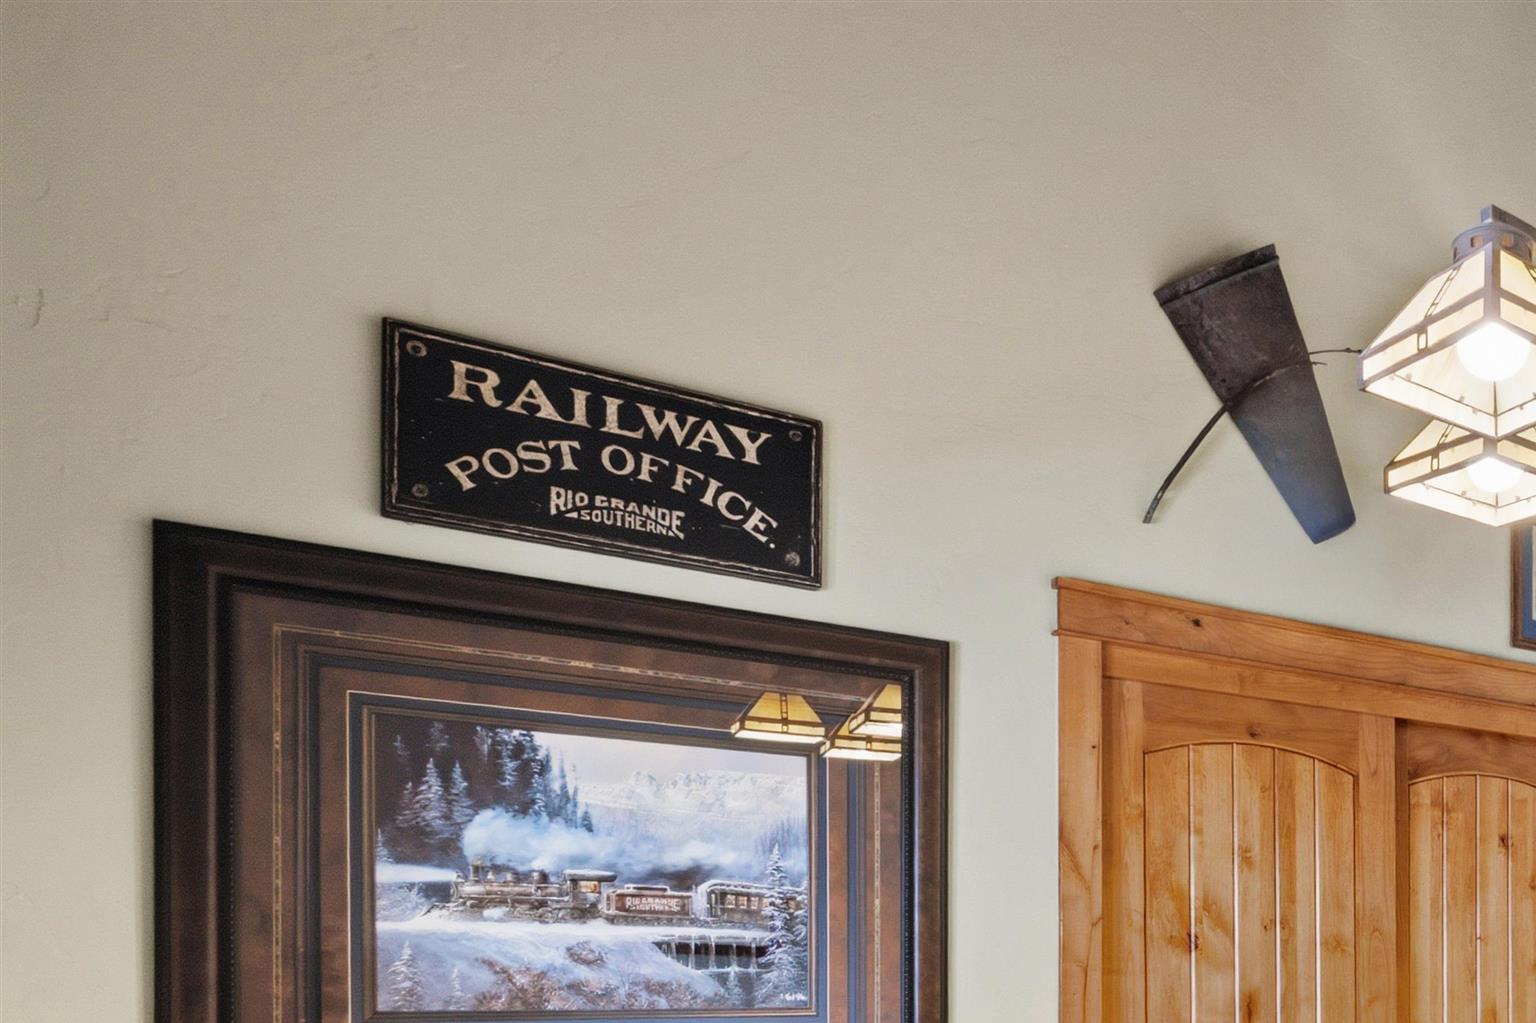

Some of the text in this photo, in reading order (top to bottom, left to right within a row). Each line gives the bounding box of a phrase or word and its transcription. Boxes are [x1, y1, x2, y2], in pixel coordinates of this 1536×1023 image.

[449, 359, 773, 466] RAILWAY
[444, 439, 778, 549] POST OFFICE.
[550, 485, 686, 540] RIO GRANDE
[580, 509, 668, 537] SOUTHERN
